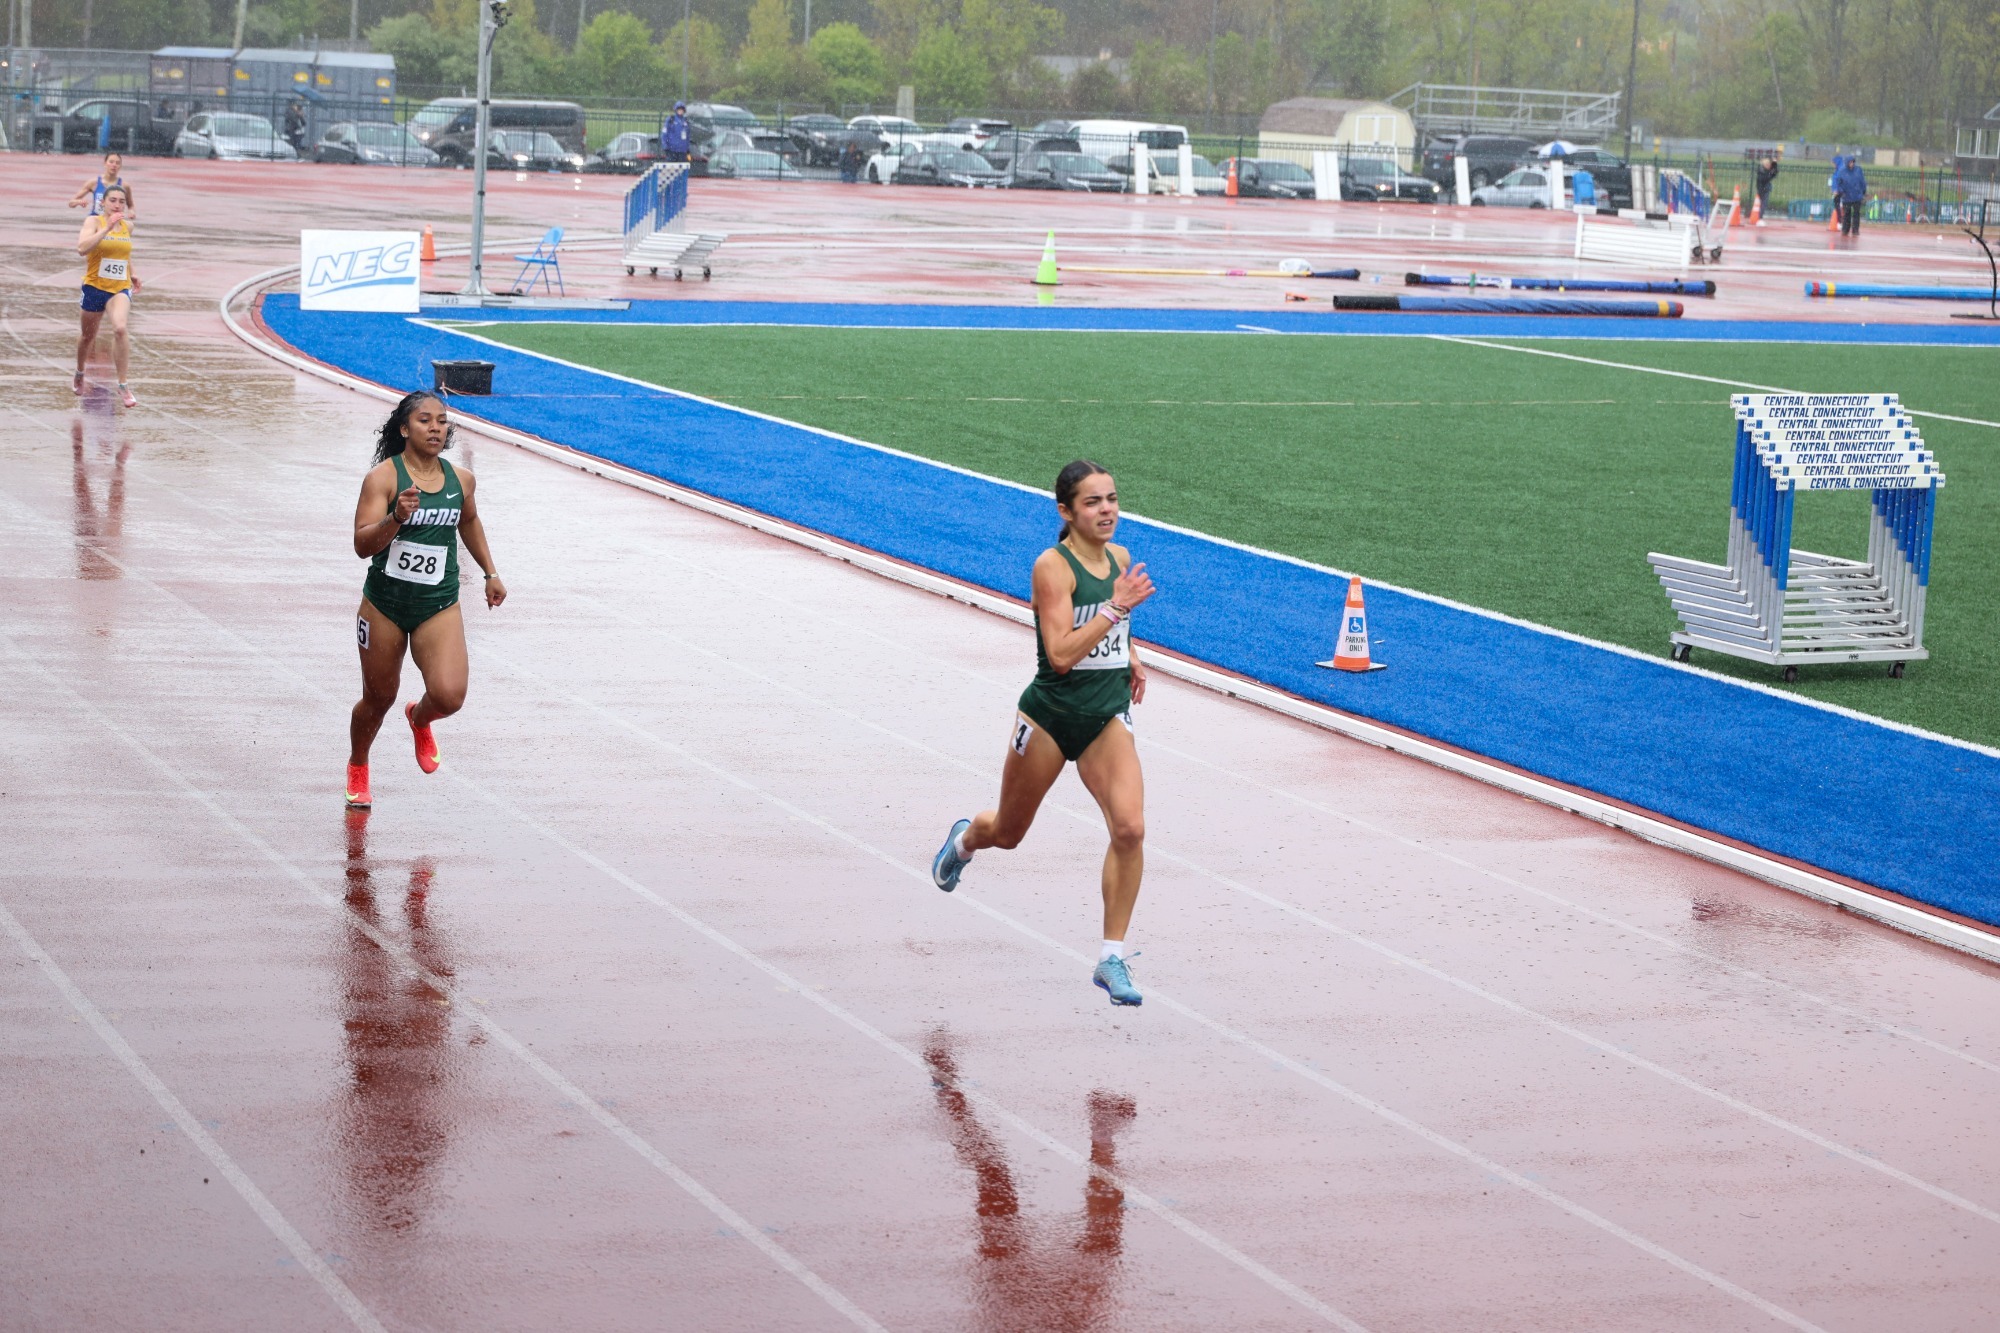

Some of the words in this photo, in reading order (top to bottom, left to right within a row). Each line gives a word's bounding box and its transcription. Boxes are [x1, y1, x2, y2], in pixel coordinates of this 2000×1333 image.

[104, 263, 124, 275] 459
[308, 242, 414, 287] NEC
[1764, 396, 1804, 406] CENTRAL
[1807, 396, 1869, 405] CONNECTICUT
[1769, 408, 1809, 417] CENTRAL
[1812, 408, 1875, 417] CONNECTICUT
[1778, 420, 1818, 429] CENTRAL
[1821, 419, 1883, 428] CONNECTICUT
[1785, 431, 1825, 440] CENTRAL
[1829, 431, 1891, 440] CONNECTICUT
[1790, 443, 1830, 452] CENTRAL
[1833, 442, 1895, 451] CONNECTICUT
[1797, 454, 1837, 464] CENTRAL
[1841, 454, 1903, 463] CONNECTICUT
[1804, 466, 1844, 476] CENTRAL
[1848, 465, 1910, 475] CONNECTICUT
[1810, 478, 1851, 488] CENTRAL
[1854, 477, 1916, 487] CONNECTICUT
[402, 508, 461, 526] AGNE
[398, 551, 437, 575] 528
[358, 619, 367, 645] 5
[1345, 635, 1366, 644] PARKING
[1349, 644, 1363, 652] ONLY
[1015, 724, 1028, 751] 4
